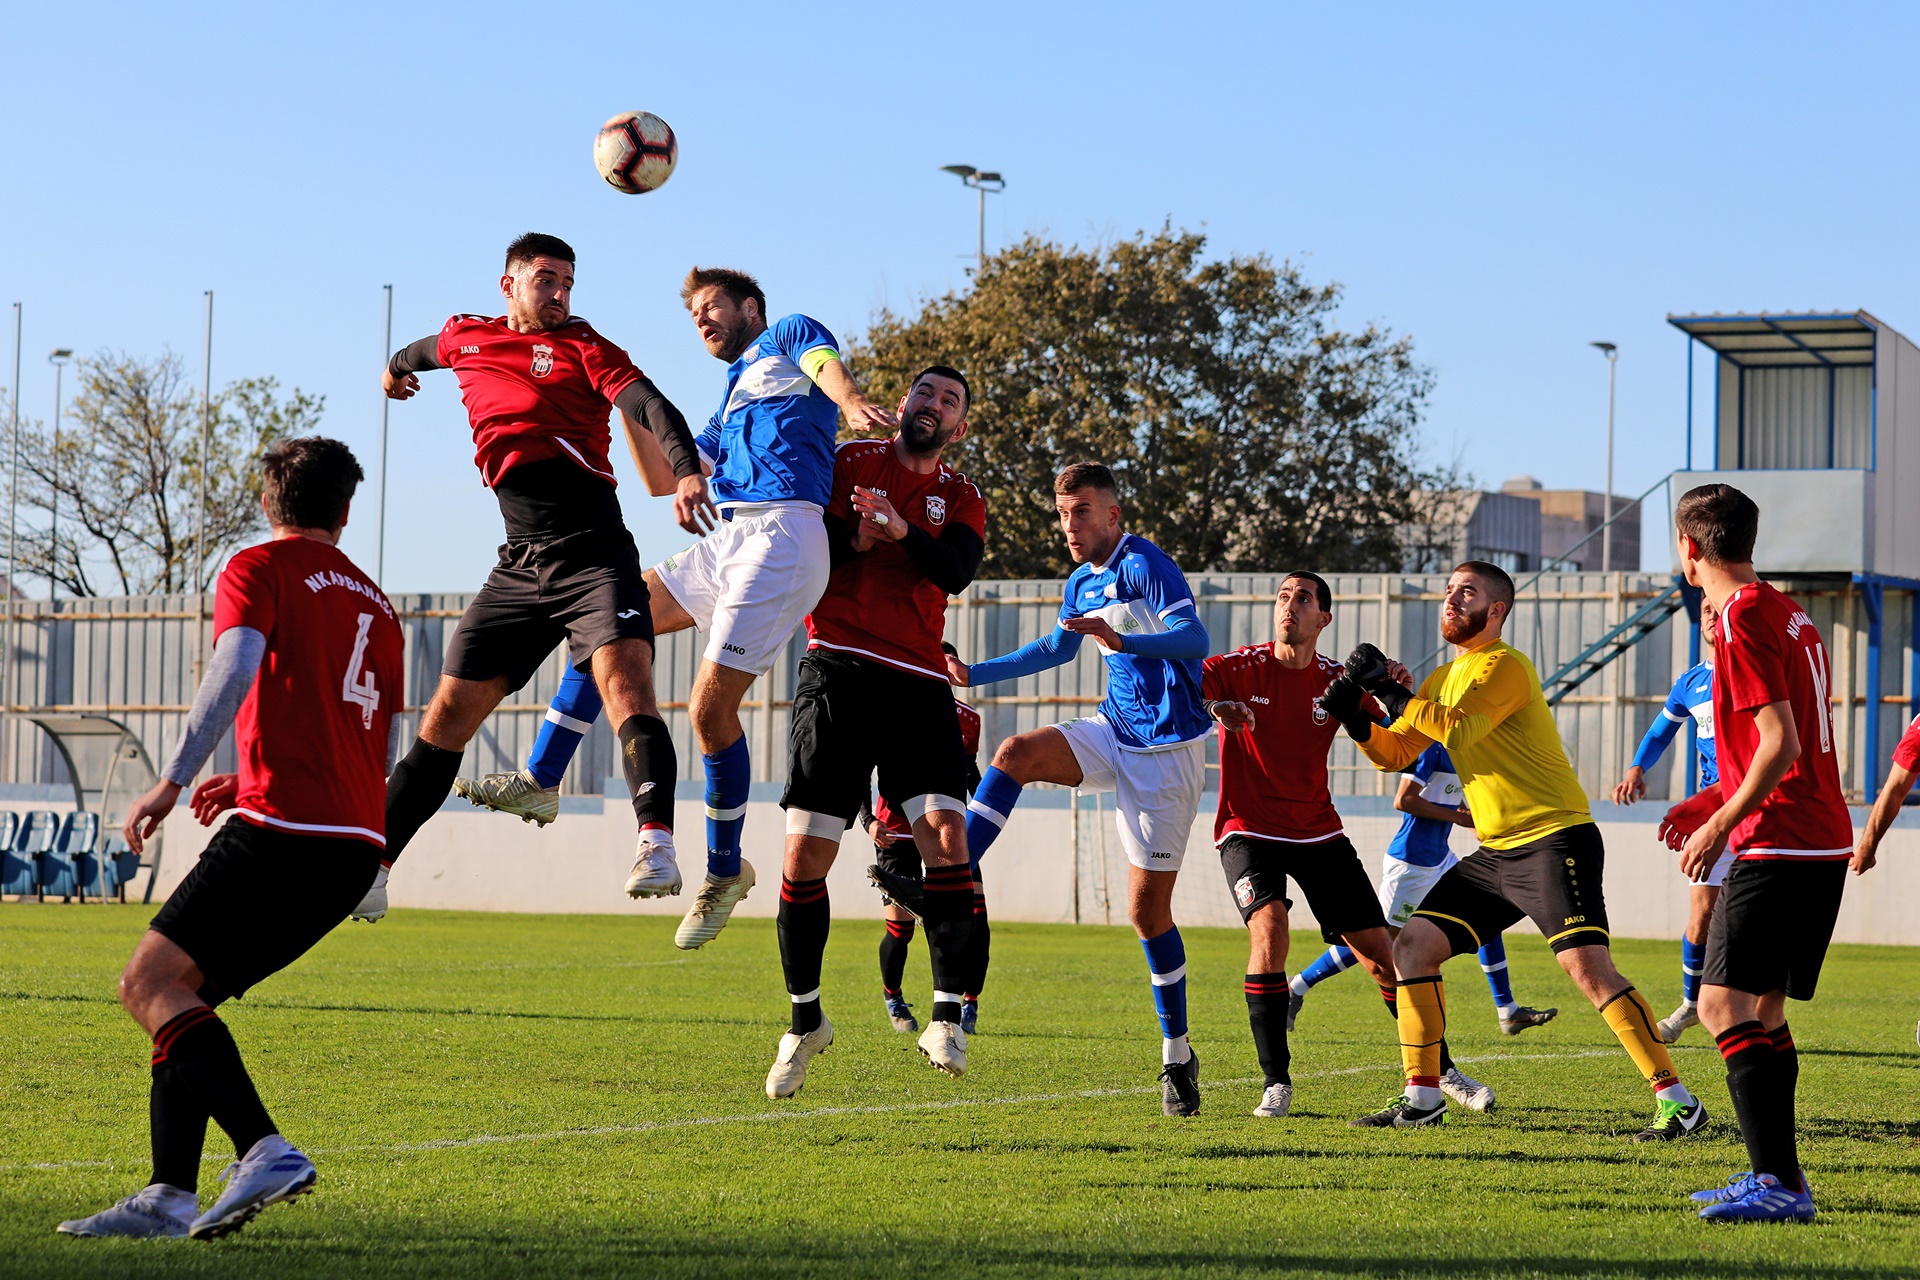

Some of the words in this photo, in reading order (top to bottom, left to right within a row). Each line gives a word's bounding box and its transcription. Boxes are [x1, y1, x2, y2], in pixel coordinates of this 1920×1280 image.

[460, 345, 480, 355] JAKO
[869, 487, 888, 498] AKO
[304, 571, 331, 594] NK
[722, 642, 746, 656] JAKO
[342, 612, 380, 730] 4
[1250, 694, 1270, 705] JAKO
[1151, 851, 1171, 860] JAKO
[1563, 915, 1586, 926] JAKO
